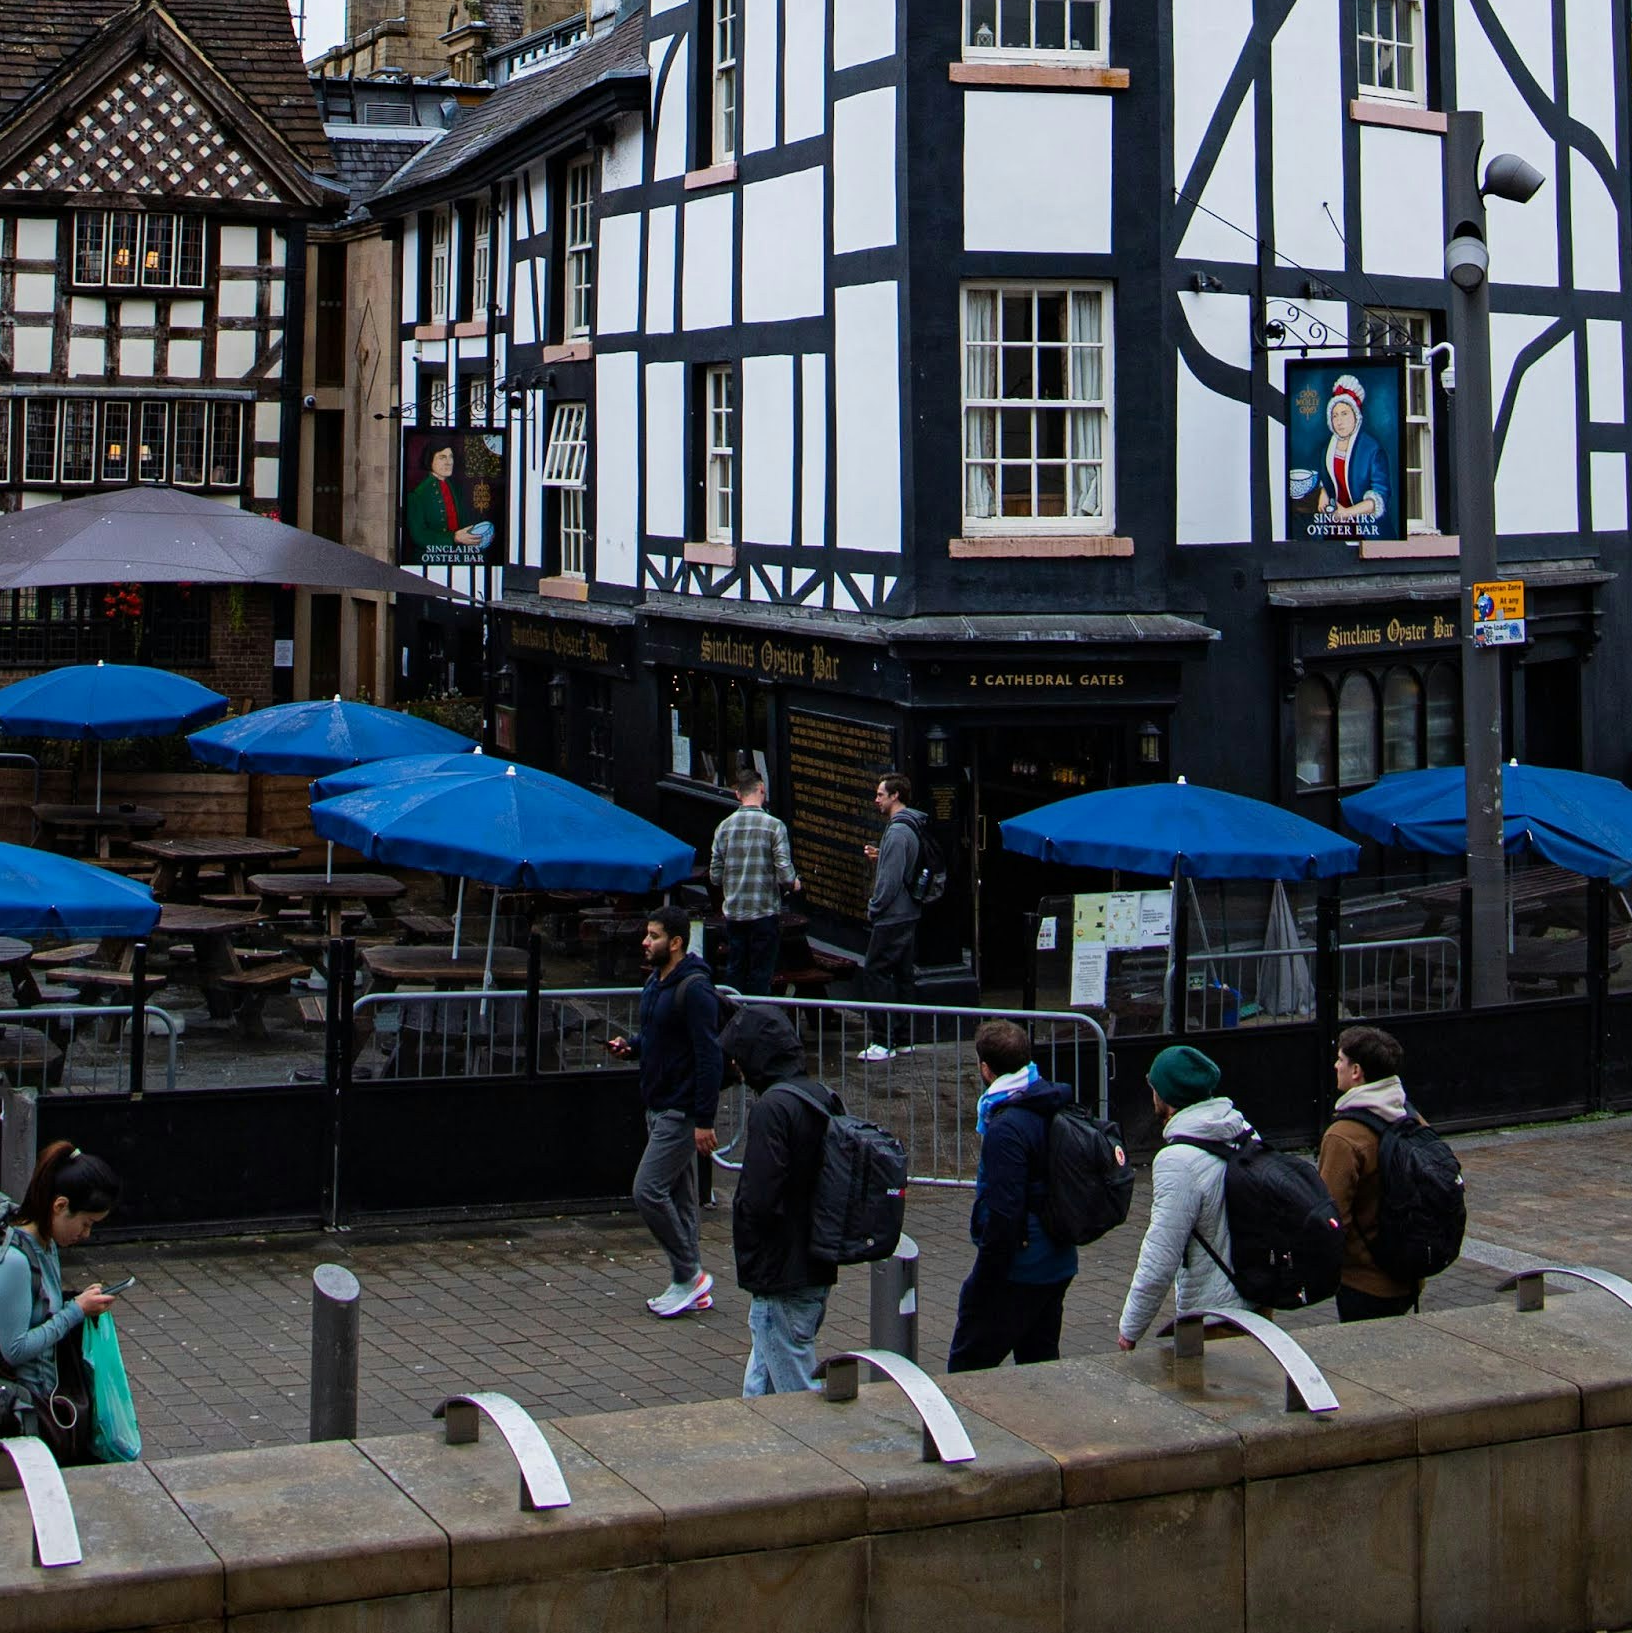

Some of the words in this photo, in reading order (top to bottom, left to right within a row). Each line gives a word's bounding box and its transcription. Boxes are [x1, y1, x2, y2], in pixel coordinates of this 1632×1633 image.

[1307, 524, 1352, 536] OYSTER
[1355, 524, 1380, 536] BAR
[421, 554, 460, 563] OYSTER
[464, 554, 484, 563] BAR
[1476, 585, 1506, 593] Pedestrian
[1509, 597, 1519, 605] any
[1326, 624, 1381, 650] Sinclairs
[1386, 617, 1427, 647] Oyster
[1432, 615, 1456, 640] Bar
[588, 632, 608, 661] Bar
[700, 630, 755, 668] Sinclairs
[760, 639, 805, 680] Oyster
[811, 643, 840, 684] Bar
[969, 674, 978, 686] 2
[984, 674, 1073, 686] CATHEDRAL
[1080, 674, 1125, 686] GATES
